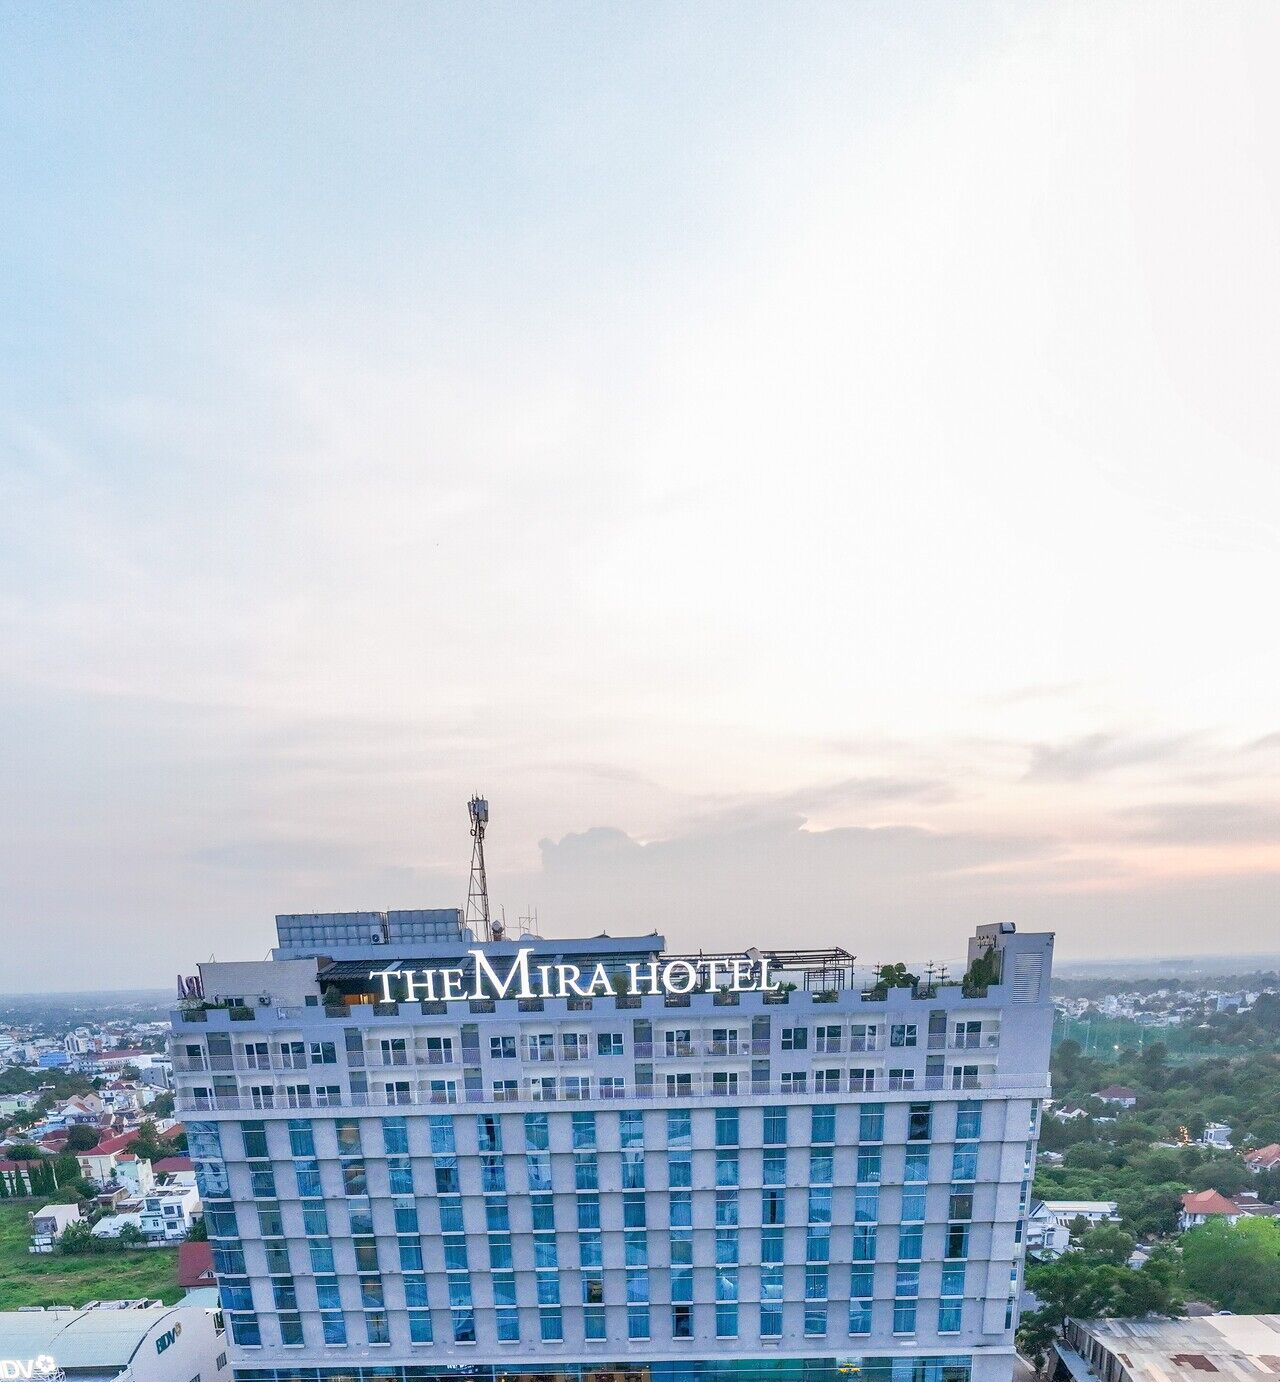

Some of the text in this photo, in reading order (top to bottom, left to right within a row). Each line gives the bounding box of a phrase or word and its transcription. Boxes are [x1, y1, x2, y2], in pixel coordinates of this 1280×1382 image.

[369, 948, 785, 1003] THE MIRA HOTEL
[156, 1327, 175, 1355] BIDV
